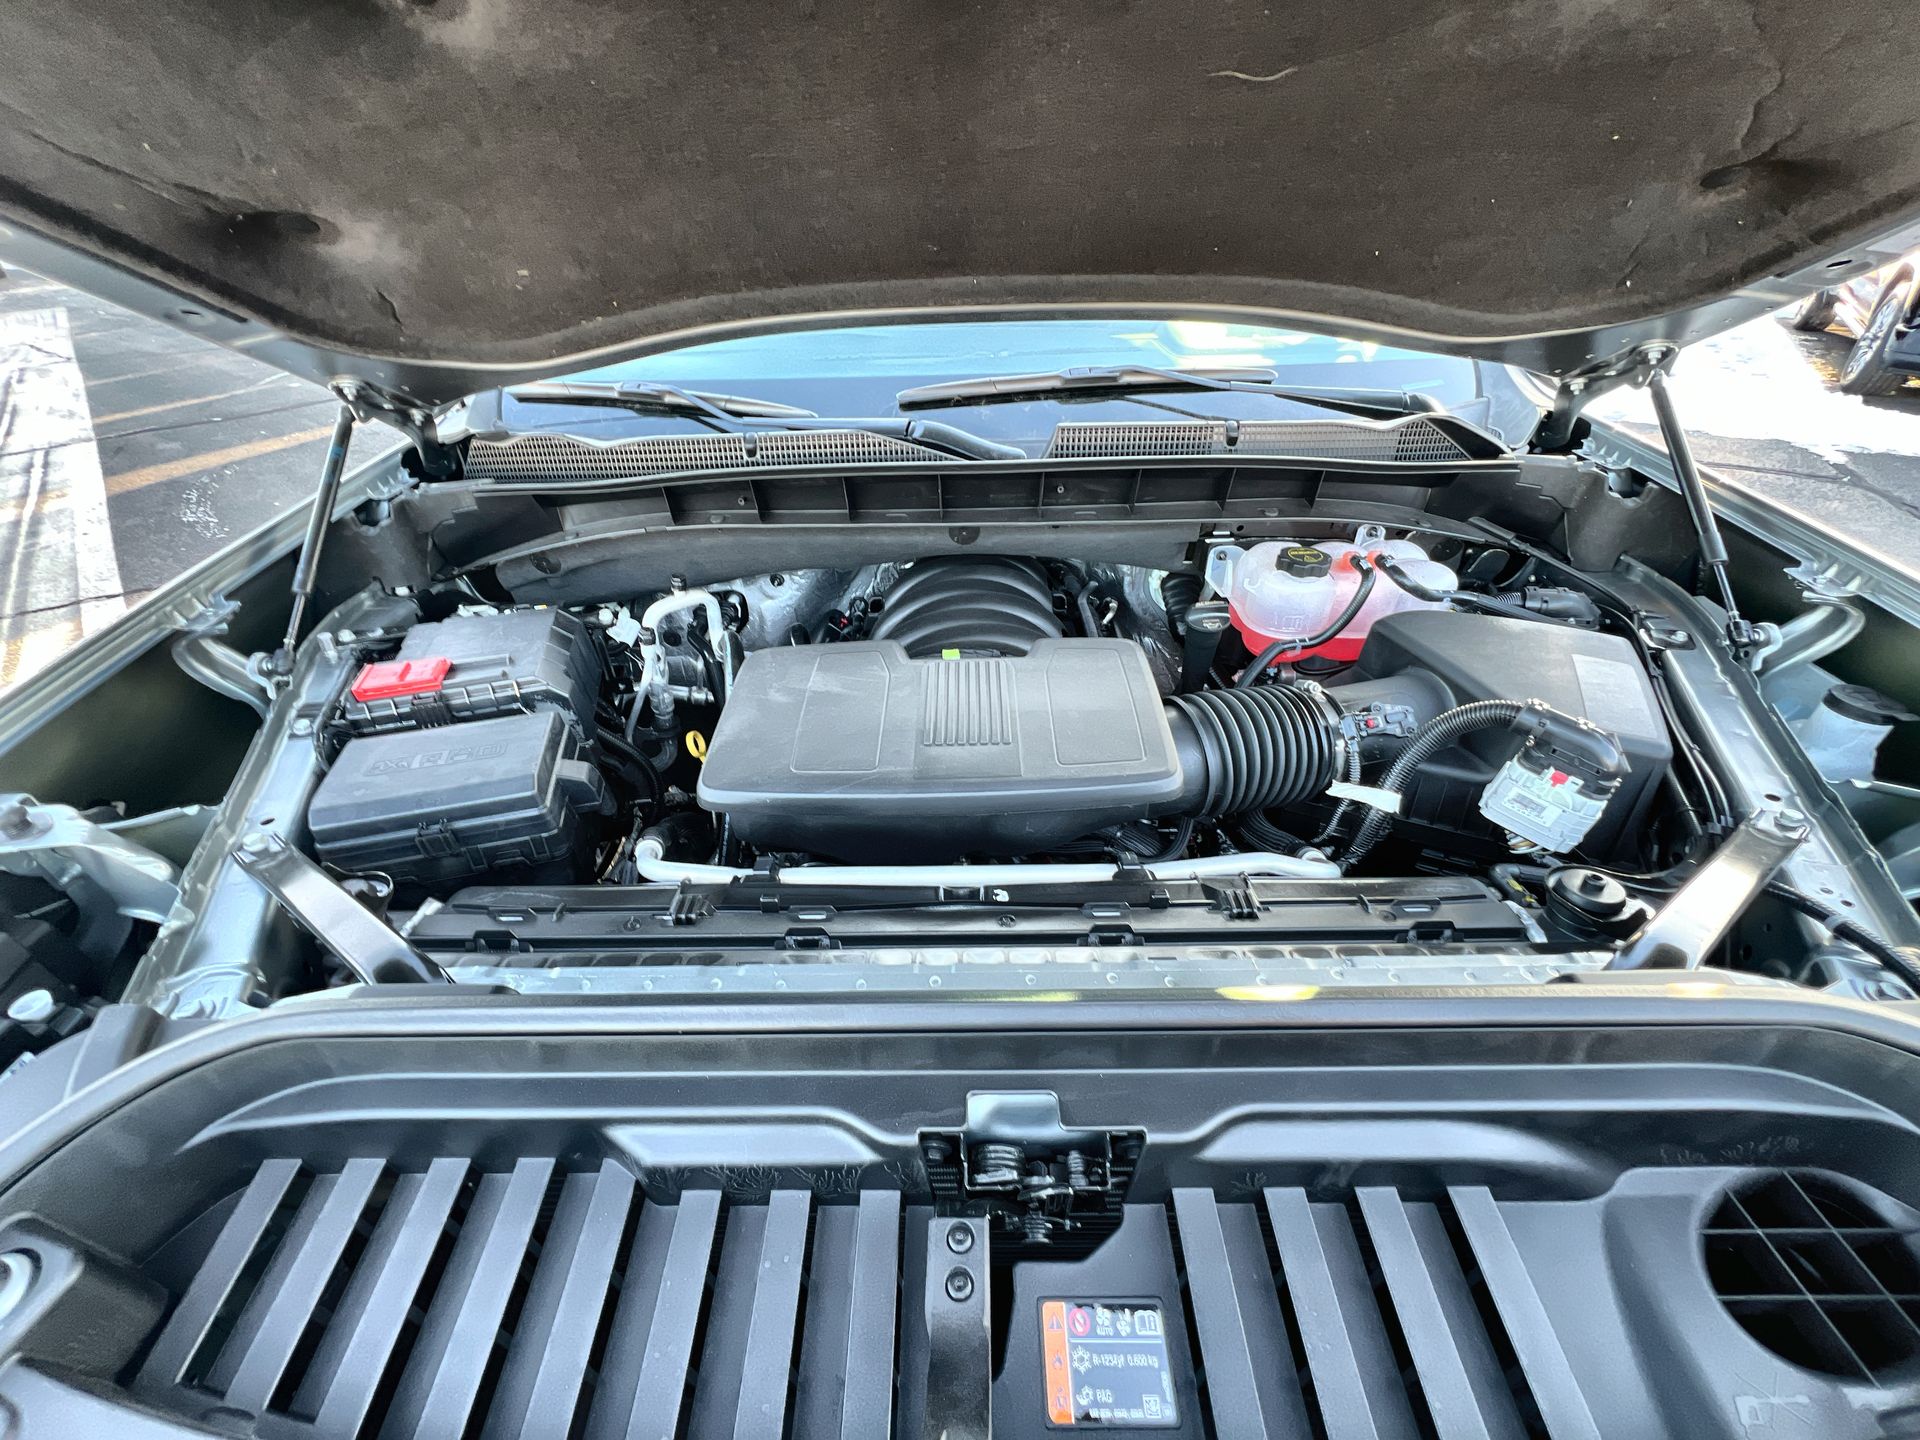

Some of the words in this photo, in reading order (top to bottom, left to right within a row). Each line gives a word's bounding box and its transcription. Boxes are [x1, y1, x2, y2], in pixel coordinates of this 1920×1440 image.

[1096, 1327, 1114, 1336] AUTO
[1092, 1353, 1125, 1369] R-1234yf
[1148, 1353, 1159, 1369] kg
[1096, 1388, 1113, 1404] PAG
